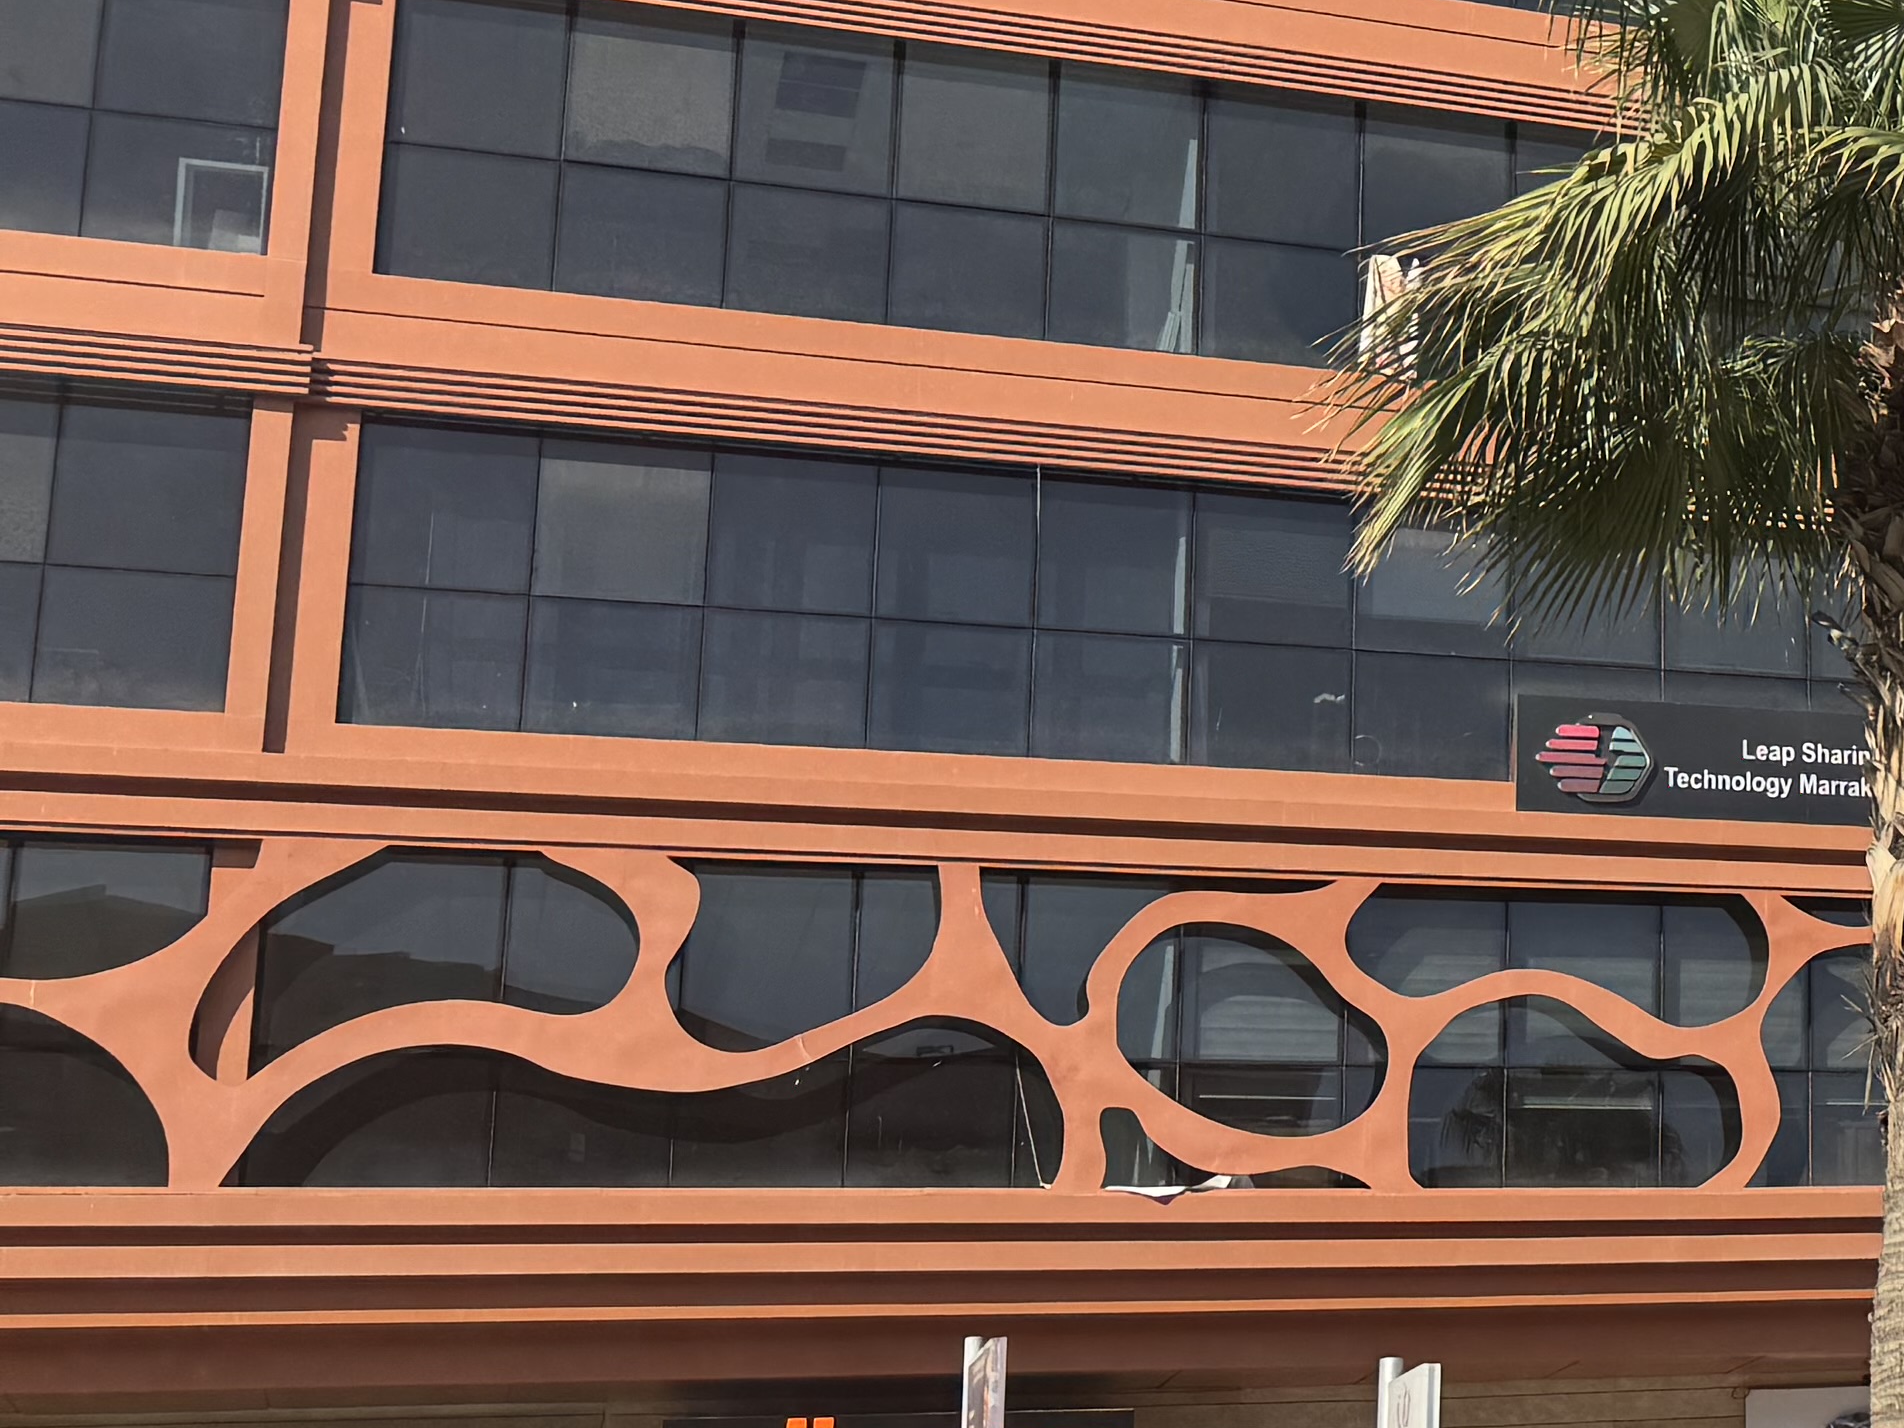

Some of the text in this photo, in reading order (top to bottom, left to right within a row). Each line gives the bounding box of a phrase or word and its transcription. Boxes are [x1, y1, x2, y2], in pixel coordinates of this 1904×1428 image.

[1743, 739, 1871, 767] Leap Sharin
[1664, 767, 1872, 798] Technology Marrak
